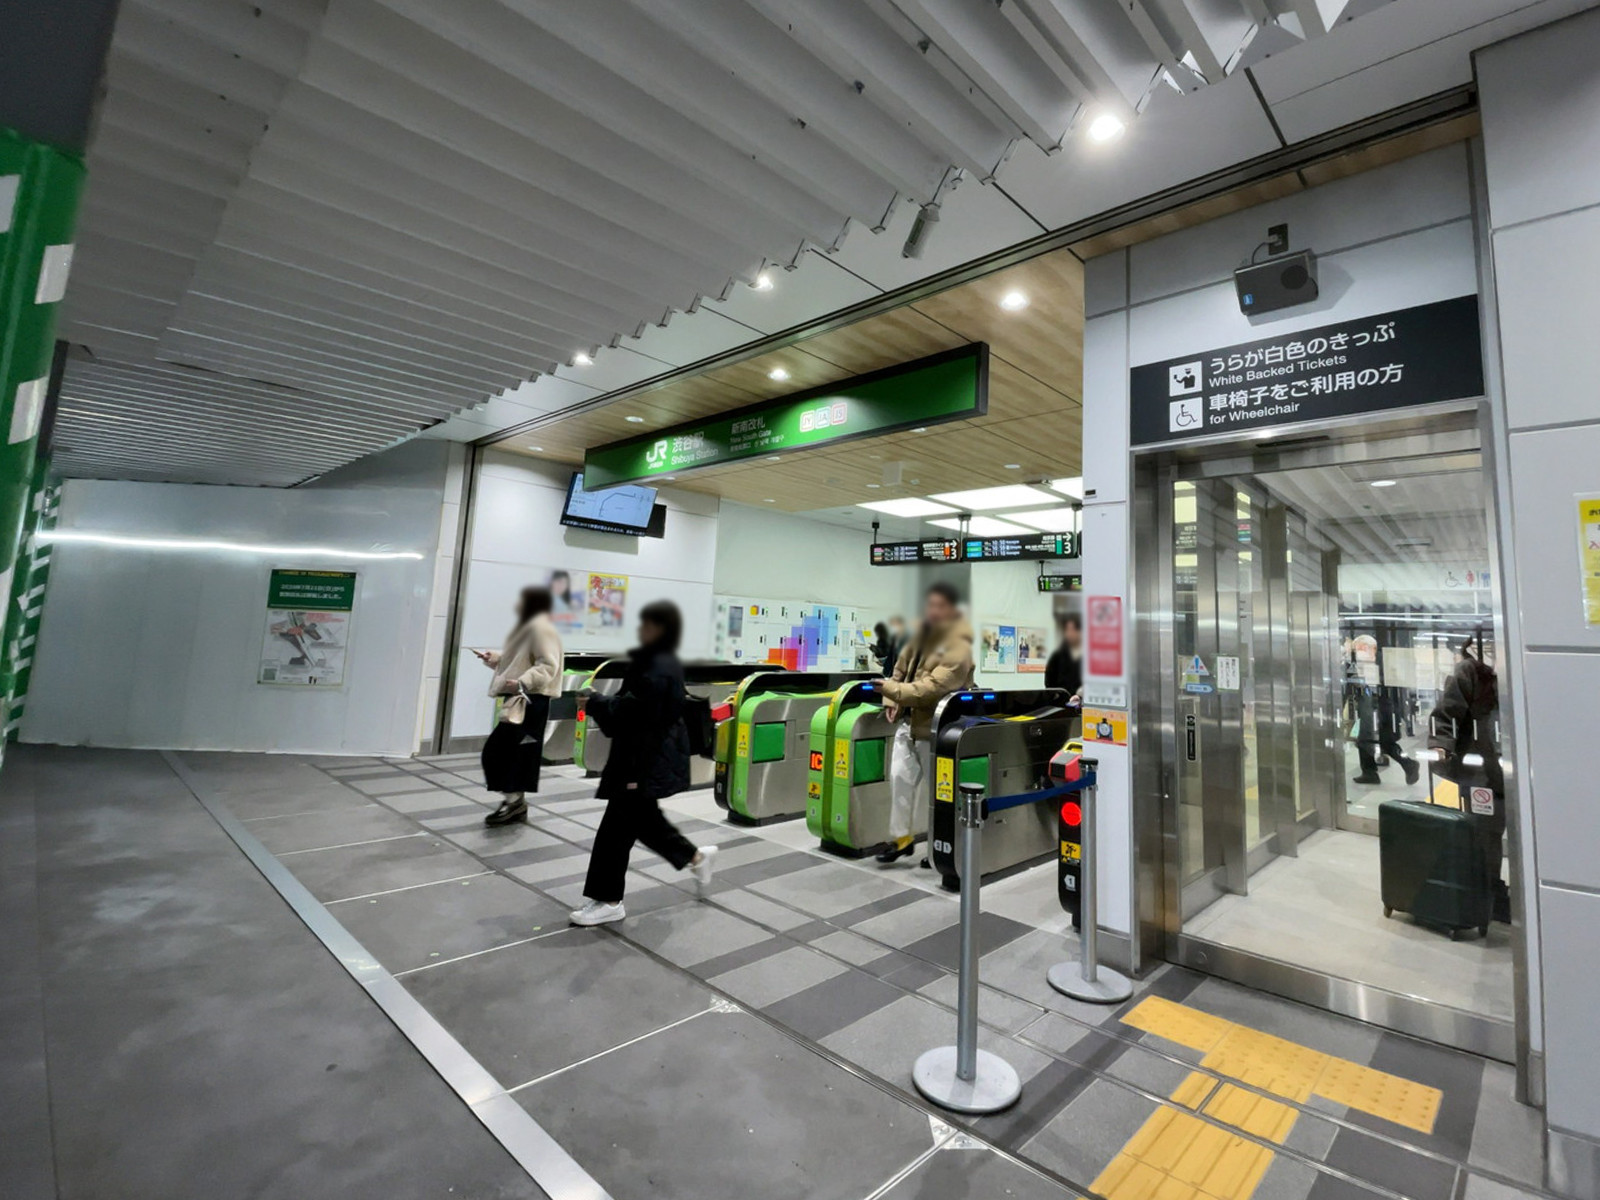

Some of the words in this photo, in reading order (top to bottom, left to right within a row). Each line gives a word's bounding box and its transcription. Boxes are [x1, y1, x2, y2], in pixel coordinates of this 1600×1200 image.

[1209, 320, 1396, 376] うらが白色のきっぷ
[1208, 374, 1244, 388] White
[1246, 362, 1294, 381] Backed
[1297, 355, 1347, 372] Tickets
[1208, 363, 1405, 411] 車椅子をご利用の方
[1209, 414, 1227, 425] for
[1229, 402, 1300, 421] Wheelchair
[645, 439, 668, 463] JR
[671, 431, 705, 454] 渋谷駅
[671, 453, 695, 466] Shibuya
[695, 447, 719, 460] Station
[1063, 541, 1072, 555] 3
[810, 752, 824, 770] IC
